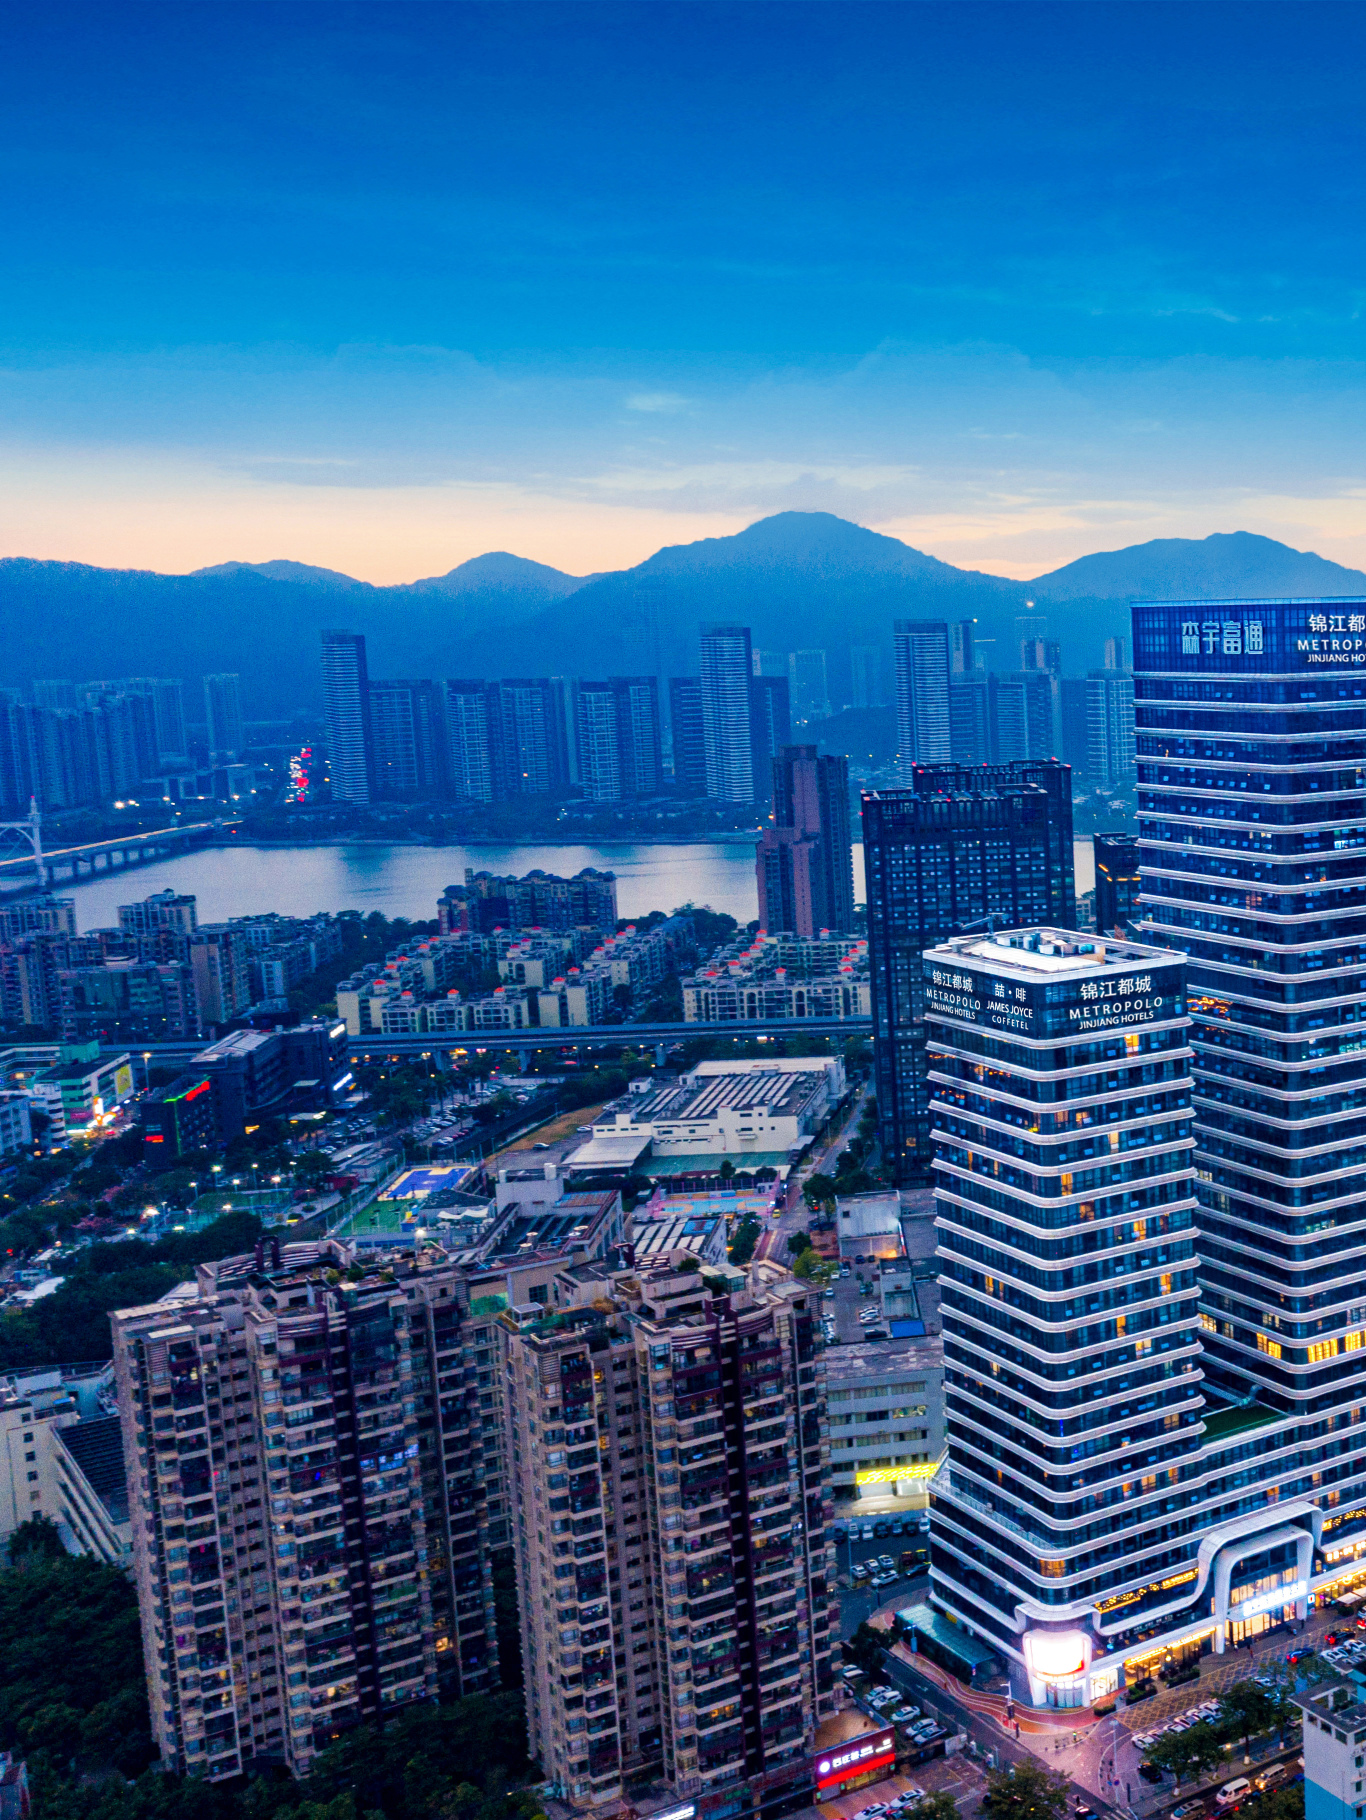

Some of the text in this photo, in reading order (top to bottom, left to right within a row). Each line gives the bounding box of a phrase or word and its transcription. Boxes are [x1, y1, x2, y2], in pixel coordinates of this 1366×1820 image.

[1307, 653, 1349, 663] JINJIANG
[932, 969, 973, 993] 锦江都城
[1080, 975, 1152, 1000] 锦江都城
[926, 987, 981, 1010] METROPOLO
[1069, 996, 1163, 1020] METROPOLO
[931, 1001, 976, 1020] JINJIANG HOTELS
[986, 1000, 1034, 1019] JAMES JOYCE
[991, 1014, 1029, 1030] COFFETEL
[1079, 1010, 1154, 1030] JINJIANG HOTELS
